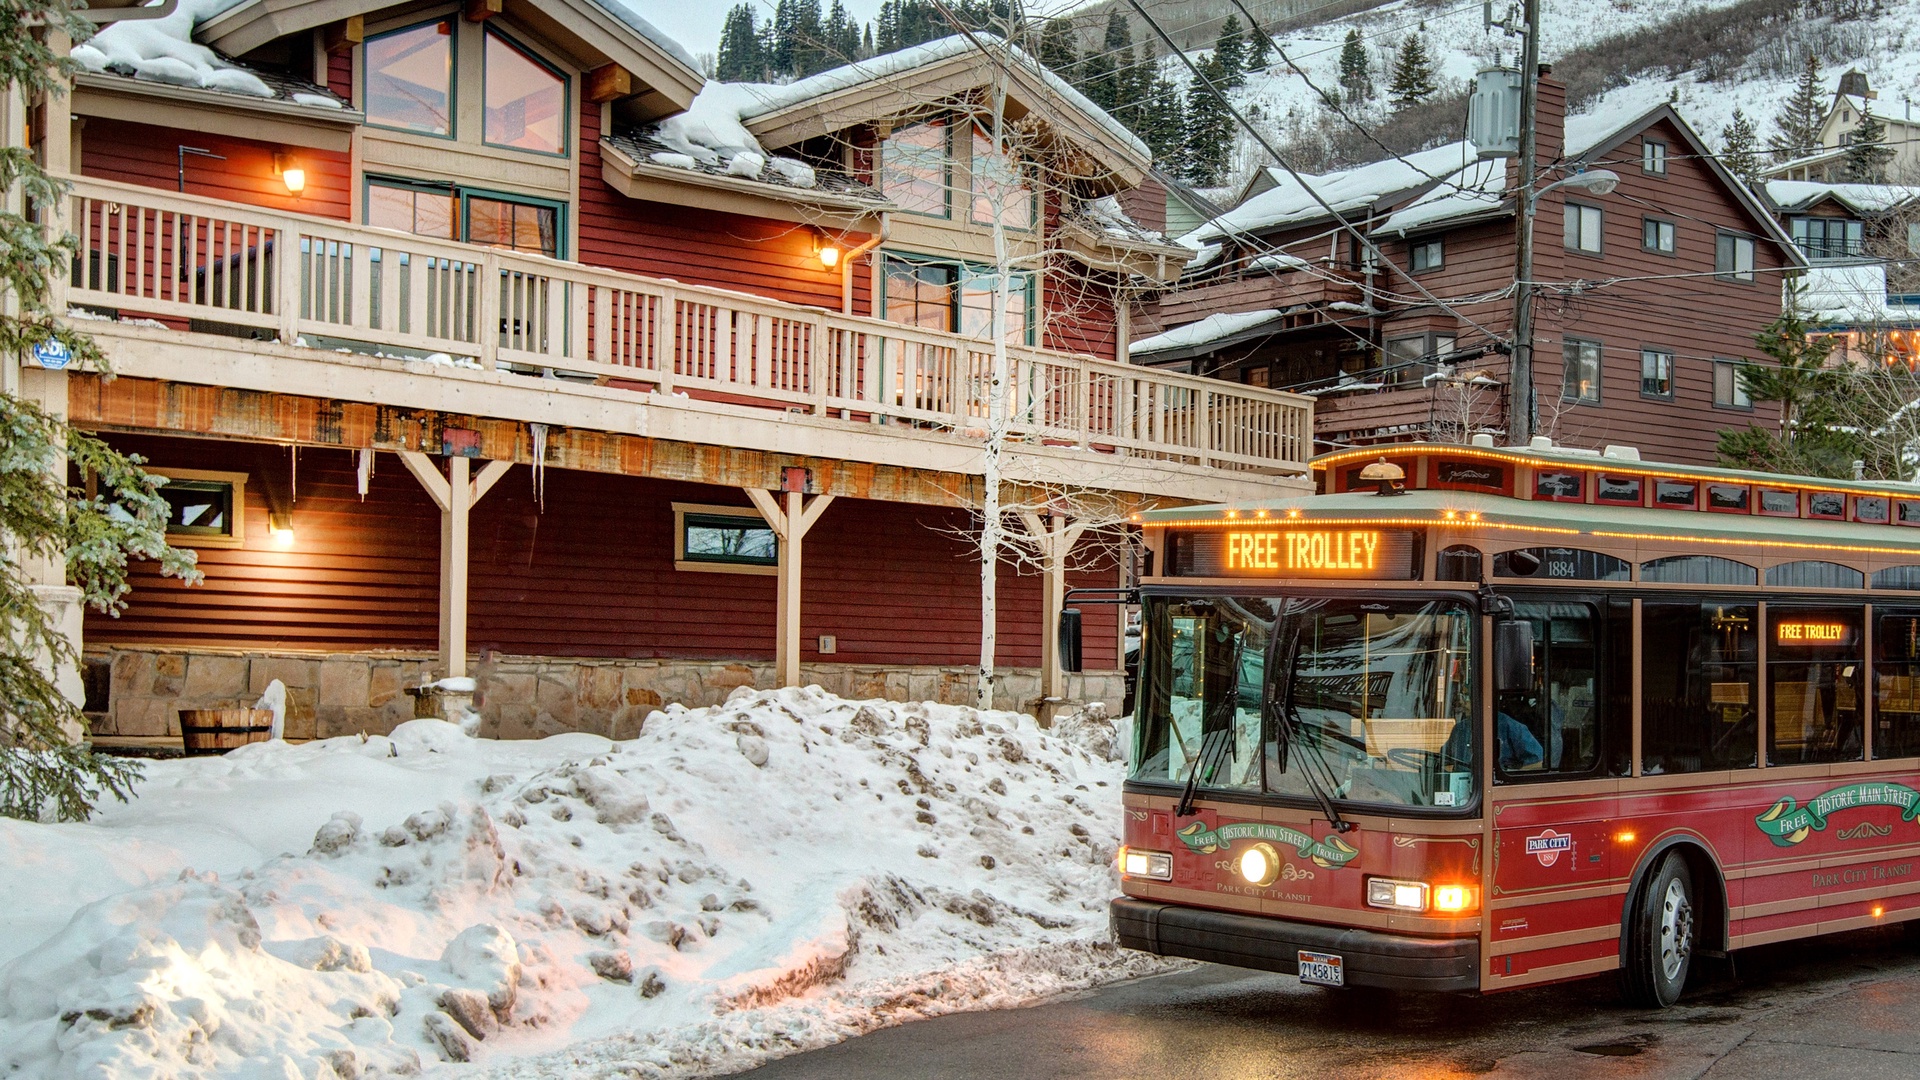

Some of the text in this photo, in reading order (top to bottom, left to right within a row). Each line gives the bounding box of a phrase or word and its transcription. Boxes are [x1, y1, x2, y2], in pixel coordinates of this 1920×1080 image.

[1228, 532, 1378, 569] FREE TROLLEY
[1548, 561, 1576, 577] 1884
[1779, 624, 1842, 639] FREE TROLLEY
[1816, 785, 1913, 816] HISTORIC MAIN STREET
[1780, 813, 1808, 833] FREE
[1194, 835, 1216, 845] FREE
[1222, 825, 1308, 848] HISTORIC MAIN STREET
[1529, 837, 1568, 850] PARK CITY
[1316, 844, 1344, 861] TROLLEY
[1812, 864, 1913, 888] PARK CITY TRANSIT
[1216, 883, 1312, 903] PARK CITY TRANSIT
[1301, 962, 1333, 980] 214581
